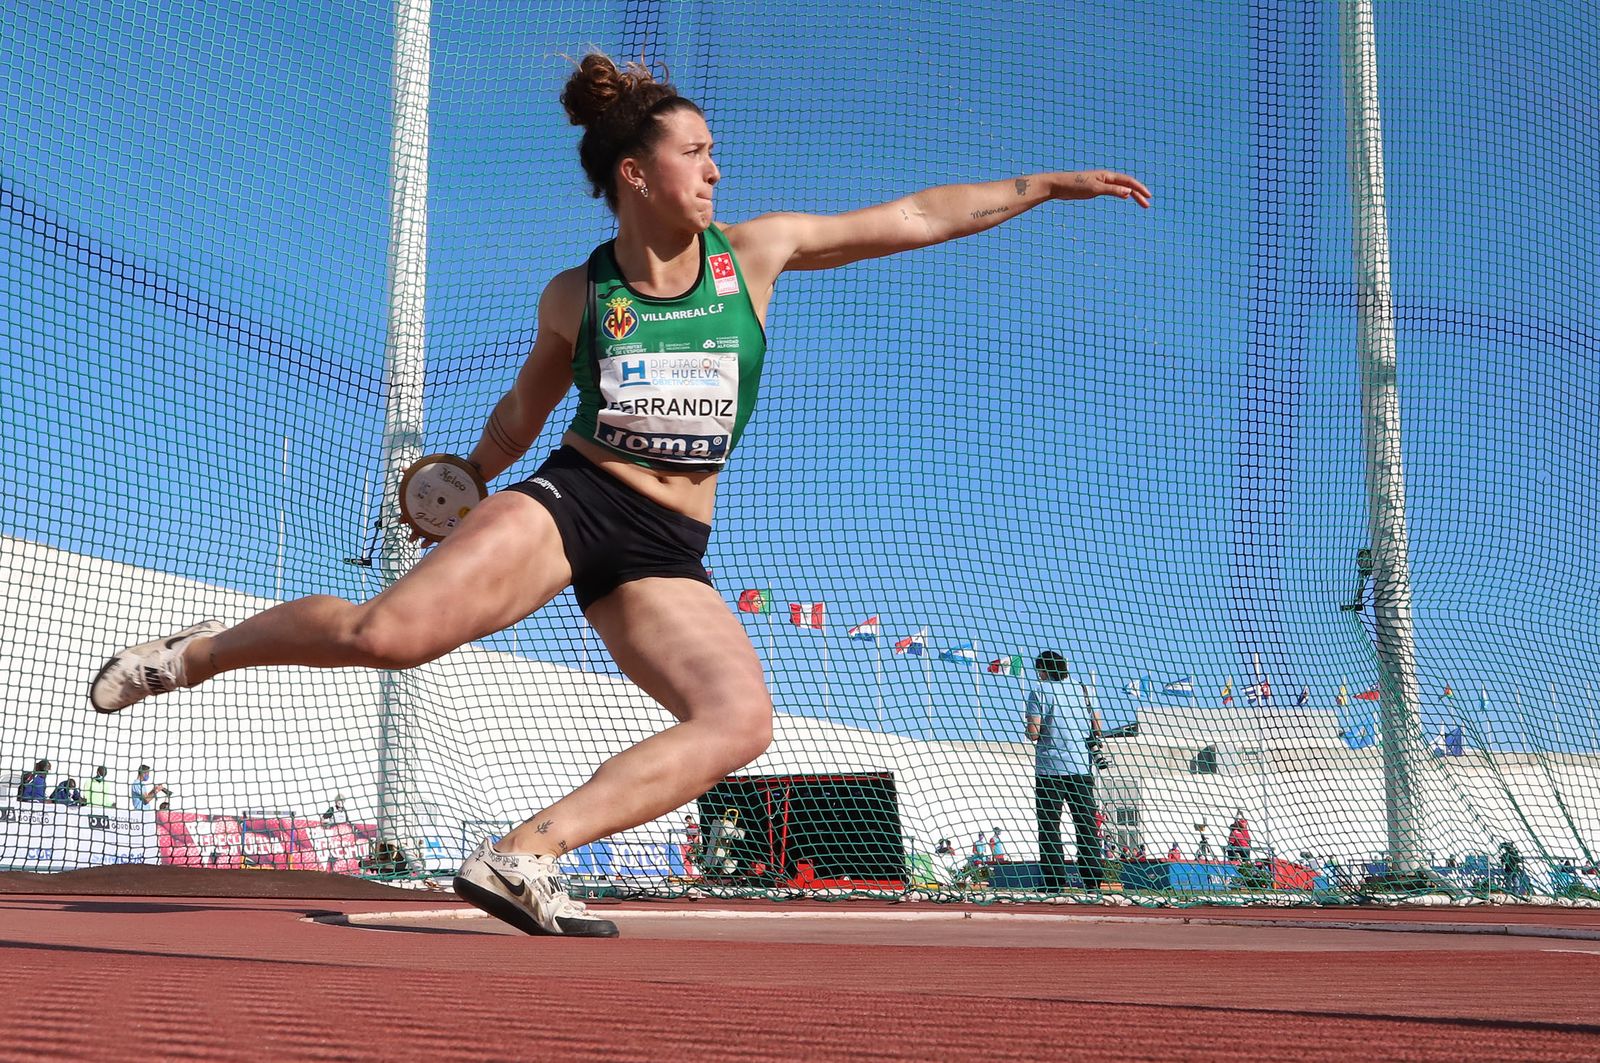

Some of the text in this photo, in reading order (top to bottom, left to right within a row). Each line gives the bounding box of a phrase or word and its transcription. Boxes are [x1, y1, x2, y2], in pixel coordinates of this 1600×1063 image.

[641, 309, 707, 322] VILLARREAL
[650, 369, 720, 379] DE HUELVA
